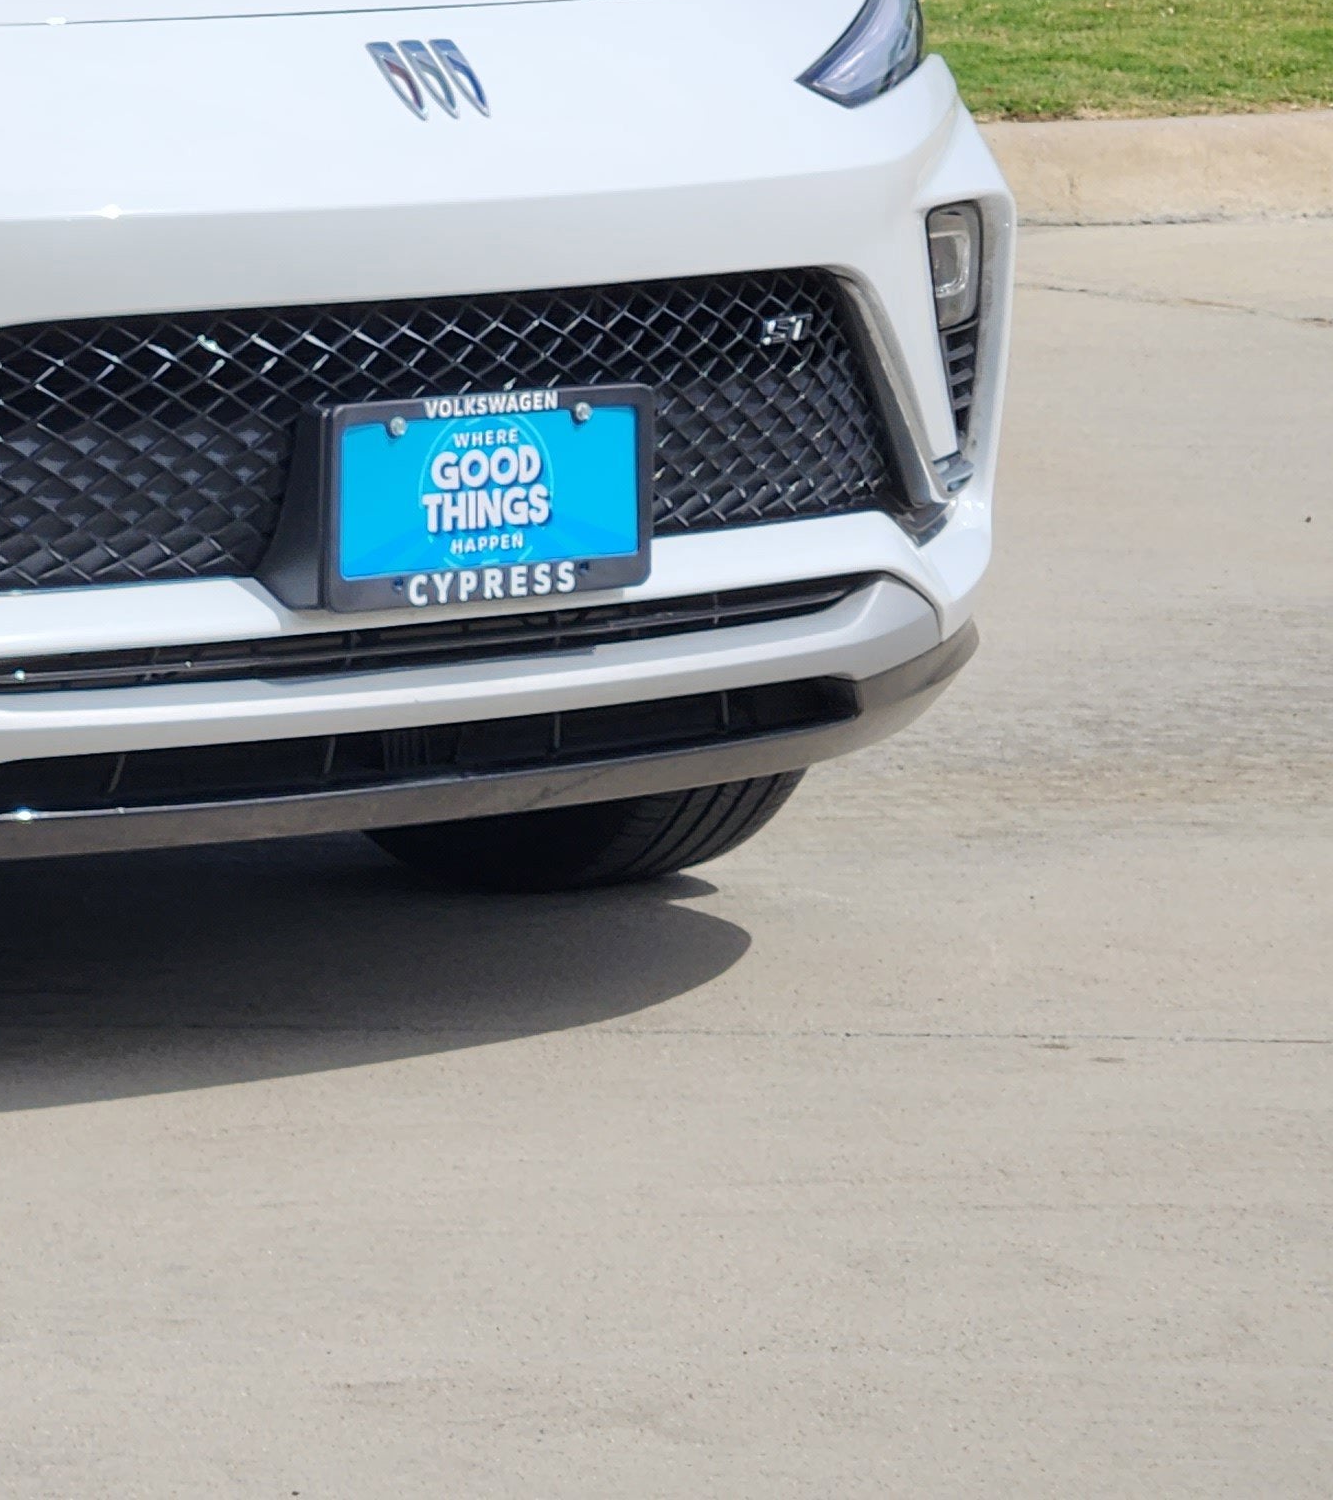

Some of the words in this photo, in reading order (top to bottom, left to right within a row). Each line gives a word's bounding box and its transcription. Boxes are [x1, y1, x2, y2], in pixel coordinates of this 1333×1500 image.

[424, 391, 558, 419] VOLKSWAGEN
[453, 429, 519, 448] WHERE
[431, 445, 541, 490] GOOD
[422, 484, 550, 532] THINGS
[450, 533, 524, 555] HAPPEN
[408, 561, 576, 606] CYPRESS
